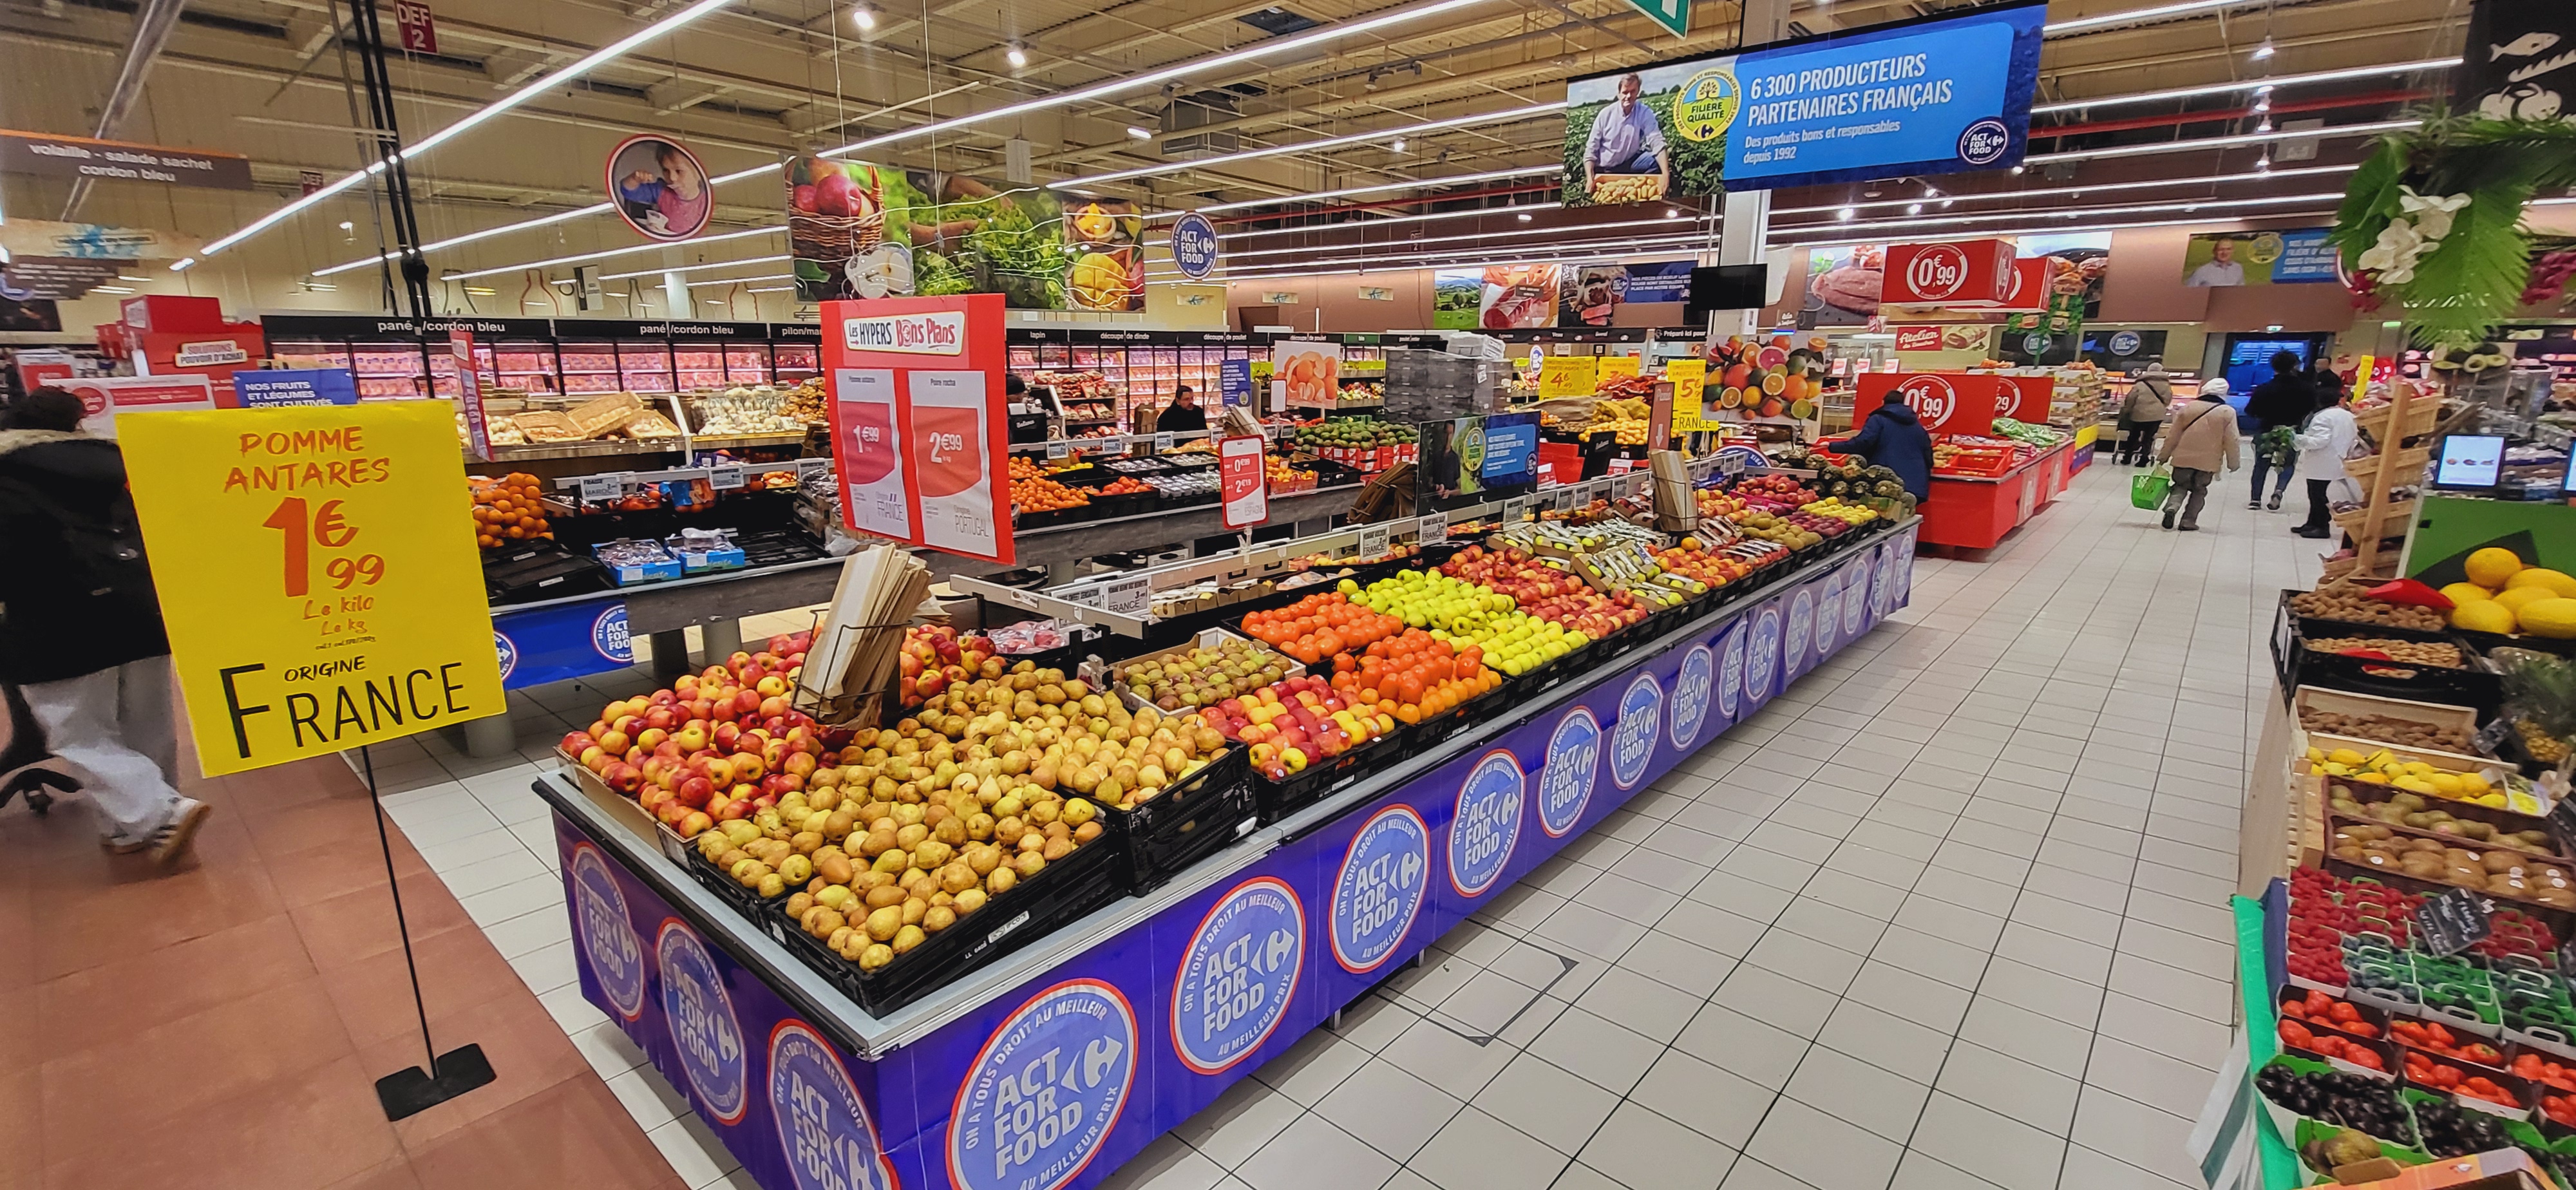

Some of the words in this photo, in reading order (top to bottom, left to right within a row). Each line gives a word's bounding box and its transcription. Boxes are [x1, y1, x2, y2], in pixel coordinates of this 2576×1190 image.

[397, 3, 430, 26] DEF
[412, 29, 426, 48] 2
[1750, 78, 1761, 100] 6
[1765, 73, 1796, 98] 300
[1799, 53, 1926, 94] PRODUCTEURS
[1691, 101, 1723, 114] FILIÈRE
[1748, 88, 1861, 127] PARTENAIRES
[1862, 79, 1953, 116] FRANÇAIS
[1687, 110, 1724, 123] QUALITÉ
[1745, 136, 1761, 149] Des
[1763, 131, 1800, 149] produits
[1802, 131, 1824, 142] bons
[1825, 129, 1835, 138] et
[1837, 120, 1900, 138] responsables
[1971, 133, 1989, 142] ACT
[28, 144, 91, 159] volaille
[105, 151, 158, 165] salade
[162, 157, 214, 171] sachet
[1744, 149, 1771, 165] depuis
[1773, 147, 1797, 160] 1992
[1969, 146, 1991, 155] FOOD
[79, 164, 138, 179] cordon
[141, 168, 176, 182] bleu
[302, 174, 322, 185] DEF
[1180, 230, 1198, 243] ACT
[1181, 243, 1197, 253] FOR
[1181, 253, 1204, 264] FOOD
[378, 320, 413, 333] pané
[477, 321, 506, 333] bleu
[640, 325, 666, 335] pané
[712, 326, 734, 335] bleu
[849, 323, 858, 337] Les
[859, 323, 892, 345] HYPERS
[926, 318, 956, 345] Plans
[1030, 331, 1046, 339] lapin
[1101, 332, 1124, 341] découpe
[180, 354, 212, 365] POUVOIR
[187, 343, 232, 355] SOLUTIONS
[245, 382, 272, 392] NOS
[273, 381, 311, 390] FRUITS
[247, 392, 261, 401] ET
[264, 389, 316, 400] LÉGUMES
[239, 426, 365, 458] POMME
[853, 424, 880, 454] 1€99
[929, 431, 963, 464] 2€99
[223, 457, 390, 495] ANTARES
[877, 500, 904, 522] FRANCE
[954, 515, 989, 538] PORTUGAL
[1422, 531, 1444, 540] FRANCE
[1363, 543, 1385, 554] FRANCE
[302, 600, 330, 619] Le
[341, 596, 374, 612] kilo
[1108, 600, 1140, 612] FRANCE
[348, 617, 368, 634] kg
[607, 620, 628, 633] ACT
[607, 630, 629, 641] FOR
[284, 656, 366, 683] ORIGINE
[1681, 674, 1698, 697] ACT
[219, 661, 470, 759] FRANCE
[1680, 693, 1694, 713] FOR
[1624, 706, 1646, 732] ACT
[1676, 704, 1696, 730] FOOD
[1621, 725, 1639, 750] FOR
[1554, 744, 1580, 775] ACT
[1620, 739, 1644, 768] FOOD
[1551, 766, 1573, 793] FOR
[1551, 780, 1579, 813] FOOD
[1467, 791, 1497, 828] ACT
[1377, 820, 1387, 835] AU
[1387, 818, 1417, 840] MEILLEUR
[1465, 817, 1492, 849] FOR
[1358, 829, 1376, 858] DROIT
[1464, 831, 1500, 871] FOOD
[1344, 860, 1359, 889] TOUS
[1354, 853, 1391, 896] ACT
[1248, 894, 1287, 915] MEILLEUR
[1341, 889, 1349, 898] A
[1353, 882, 1387, 921] FOR
[1235, 900, 1247, 915] AU
[1339, 903, 1347, 916] ON
[1006, 917, 1021, 929] IFCO
[1206, 909, 1233, 943] DROIT
[1352, 897, 1398, 944] FOOD
[1362, 948, 1372, 958] AU
[1373, 918, 1406, 956] MEILLEUR
[1404, 891, 1419, 918] PRIX
[1189, 945, 1208, 978] TOUS
[1204, 933, 1252, 987] ACT
[672, 963, 704, 1010] ACT
[1186, 981, 1196, 990] A
[1204, 966, 1248, 1015] FOR
[677, 990, 706, 1039] FOR
[1055, 999, 1108, 1021] MEILLEUR
[1184, 993, 1194, 1012] ON
[1204, 983, 1265, 1042] FOOD
[1218, 1043, 1229, 1056] AU
[1231, 1006, 1277, 1051] MEILLEUR
[1275, 974, 1291, 1005] PRIX
[1035, 1007, 1052, 1028] AU
[679, 1018, 720, 1078] FOOD
[994, 1021, 1032, 1066] DROIT
[823, 1058, 864, 1129] MEILLEUR
[972, 1067, 998, 1110] TOUS
[994, 1046, 1061, 1118] ACT
[790, 1070, 829, 1132] ACT
[968, 1112, 981, 1124] A
[994, 1086, 1058, 1149] FOR
[791, 1103, 833, 1166] FOR
[965, 1128, 979, 1150] ON
[996, 1100, 1083, 1180] FOOD
[1019, 1177, 1037, 1190] AU
[1039, 1125, 1099, 1185] MEILLEUR
[1096, 1086, 1119, 1122] PRIX
